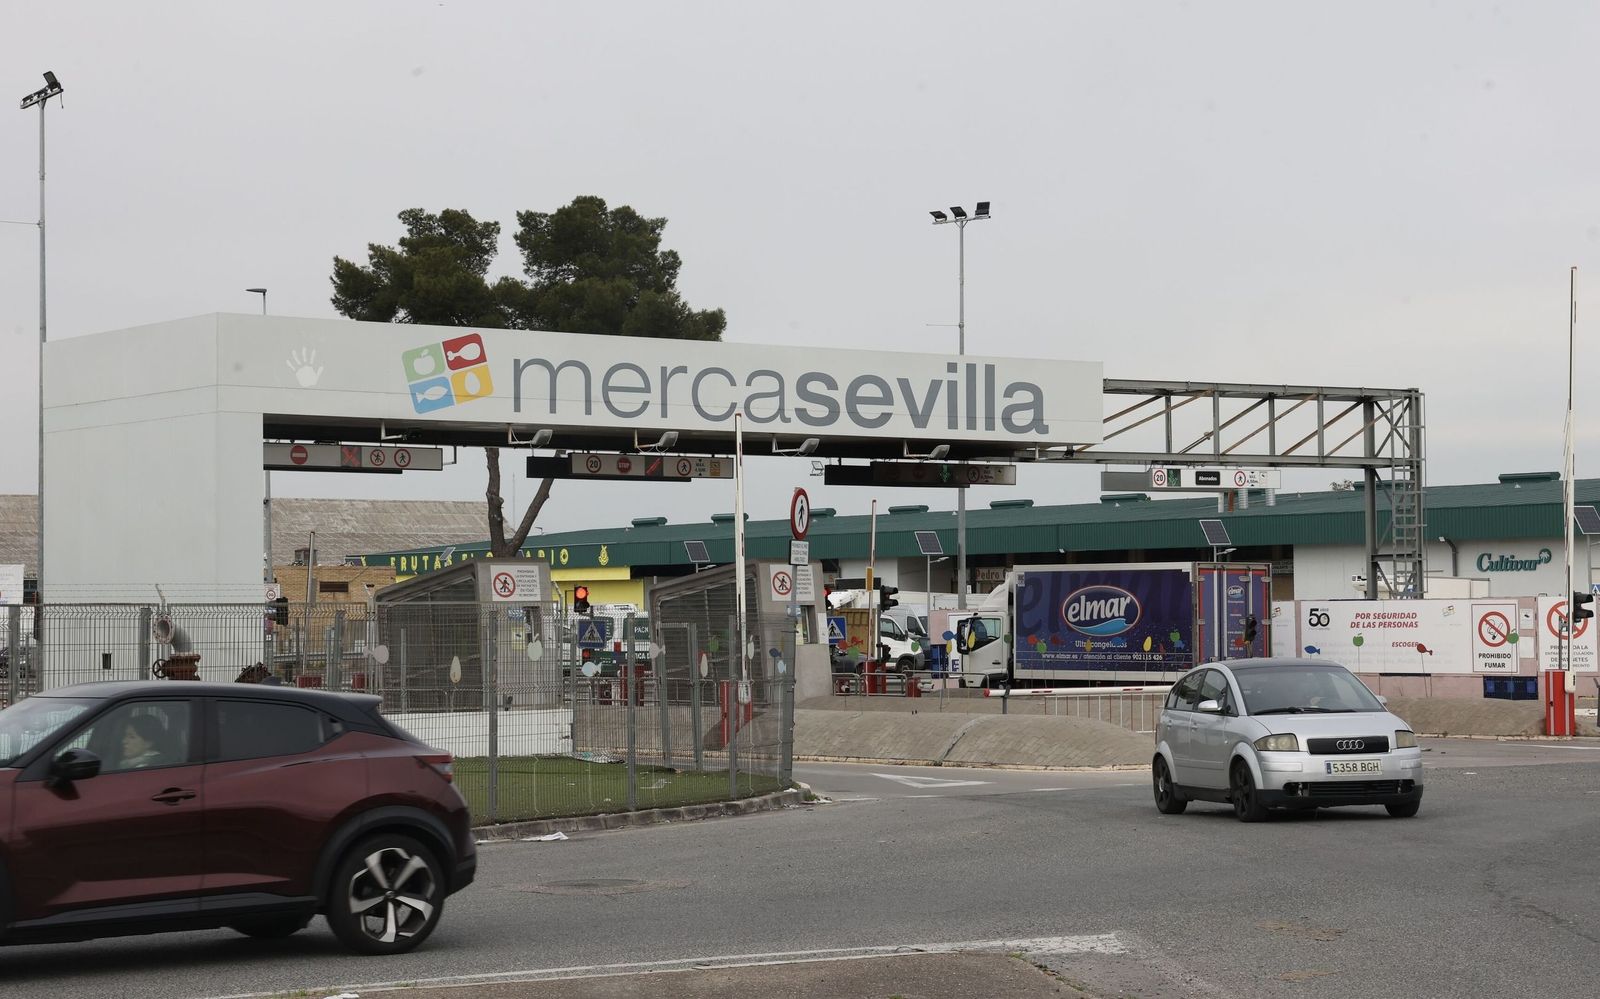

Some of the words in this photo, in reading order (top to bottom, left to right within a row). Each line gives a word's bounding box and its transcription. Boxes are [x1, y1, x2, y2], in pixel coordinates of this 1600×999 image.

[512, 357, 1050, 436] mercasevilla
[589, 459, 599, 469] 20
[1156, 474, 1164, 482] 20
[1477, 552, 1541, 573] Cultivar
[1067, 594, 1132, 623] elmar
[1308, 607, 1331, 628] 50
[1354, 612, 1371, 620] POR
[1372, 612, 1418, 621] SEGURIDAD
[1350, 621, 1361, 629] DE
[1362, 621, 1377, 629] LAS
[1378, 621, 1419, 630] PERSONAS
[1391, 641, 1419, 649] ESCOGER
[1132, 653, 1142, 661] 902
[1478, 652, 1512, 660] PROHIBIDO
[1333, 762, 1358, 773] 5358
[1361, 762, 1379, 772] BGH
